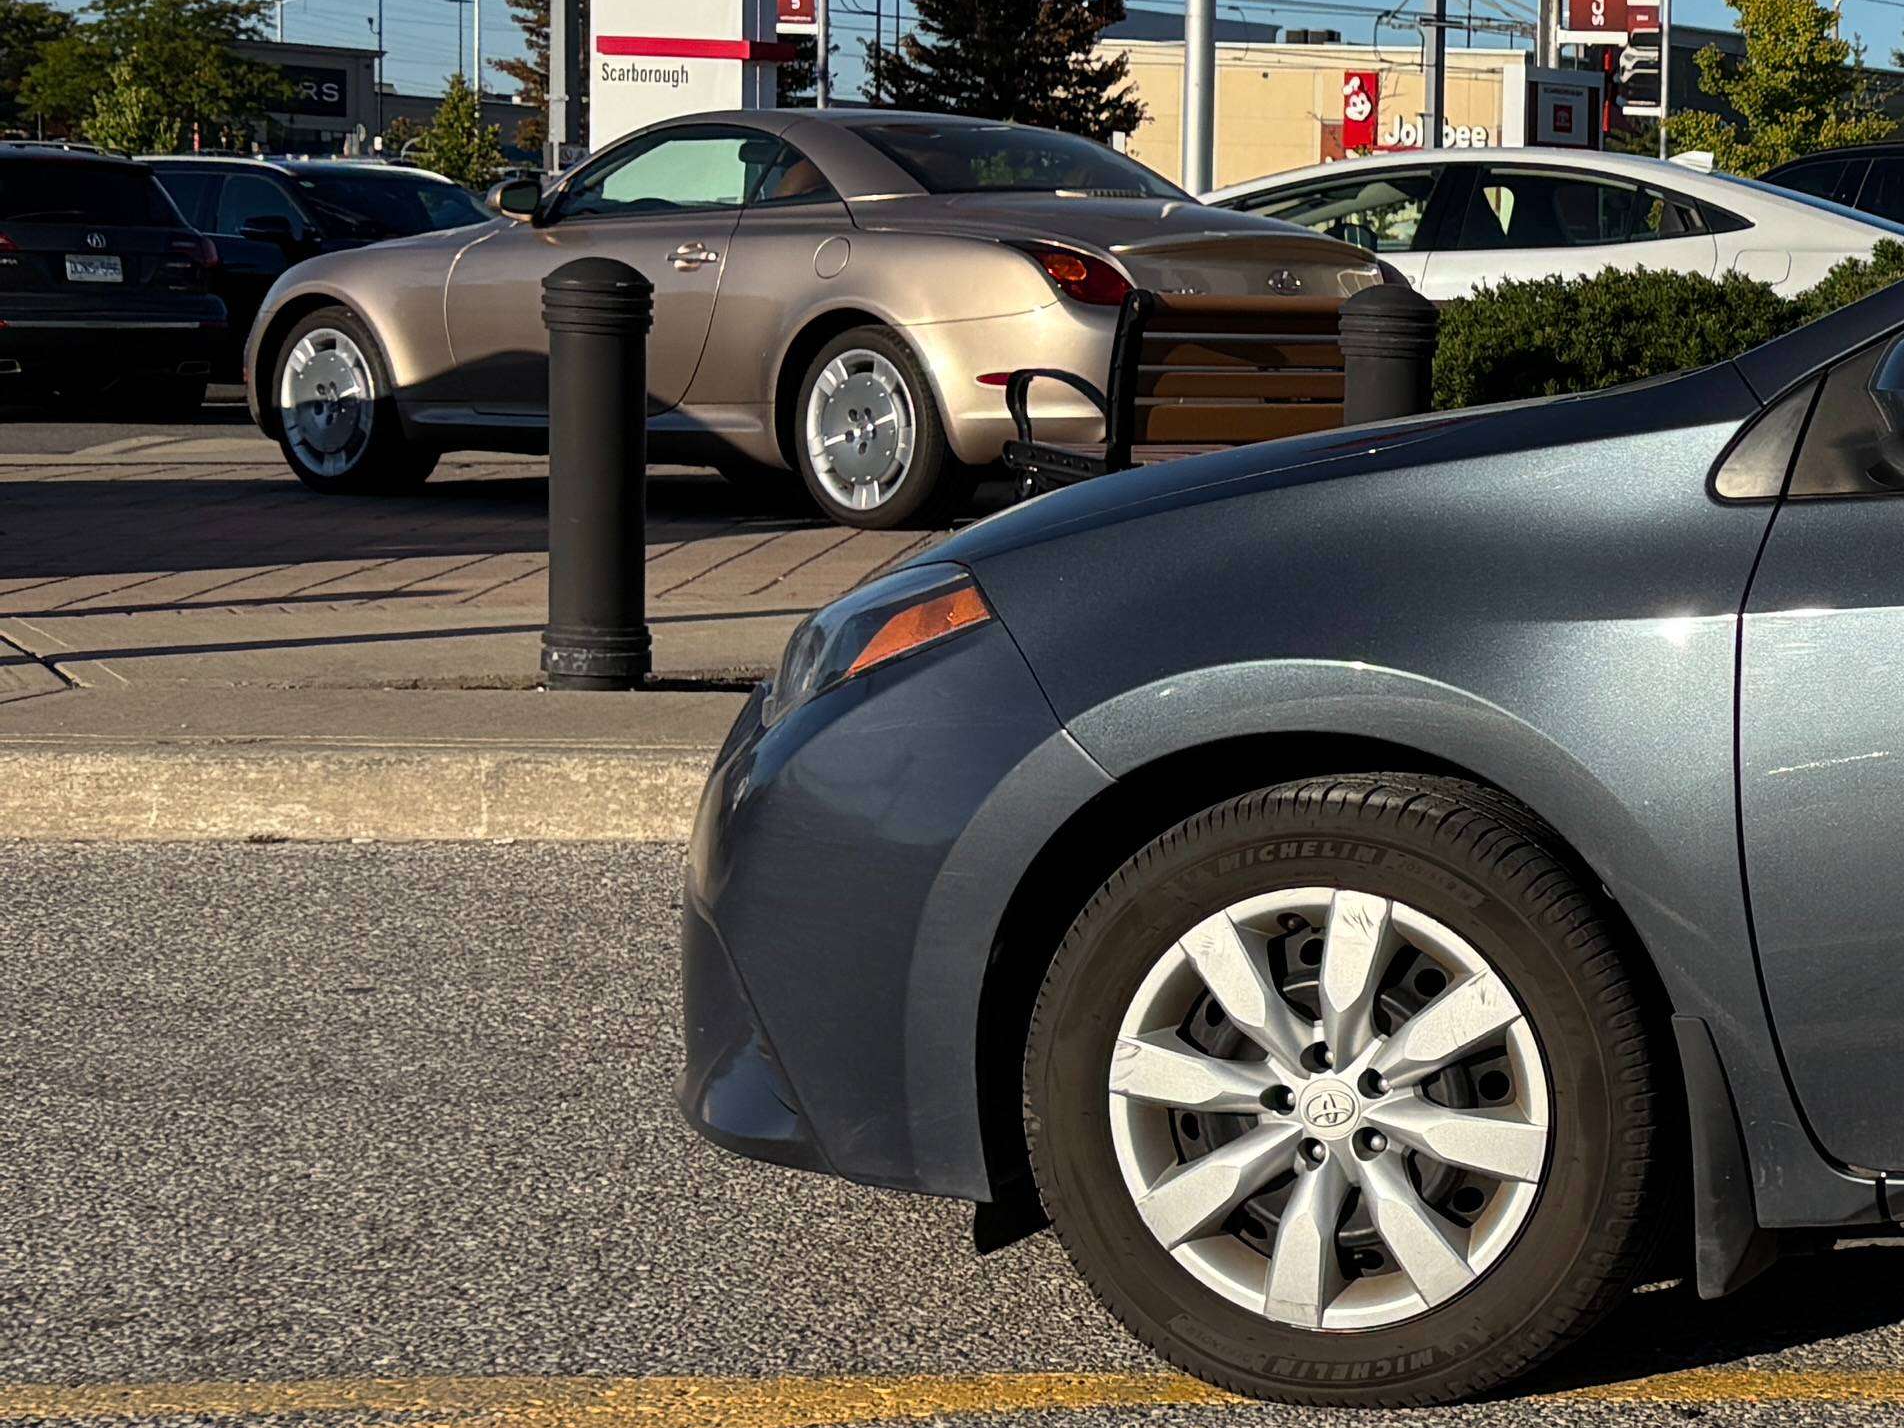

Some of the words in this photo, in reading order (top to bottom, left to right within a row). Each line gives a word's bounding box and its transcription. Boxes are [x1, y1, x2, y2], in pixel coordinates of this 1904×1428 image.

[601, 62, 689, 88] Scarborough
[1384, 114, 1488, 148] Jolbee
[1217, 839, 1378, 873] MICHELIN
[1272, 1347, 1434, 1382] MICHELIN
